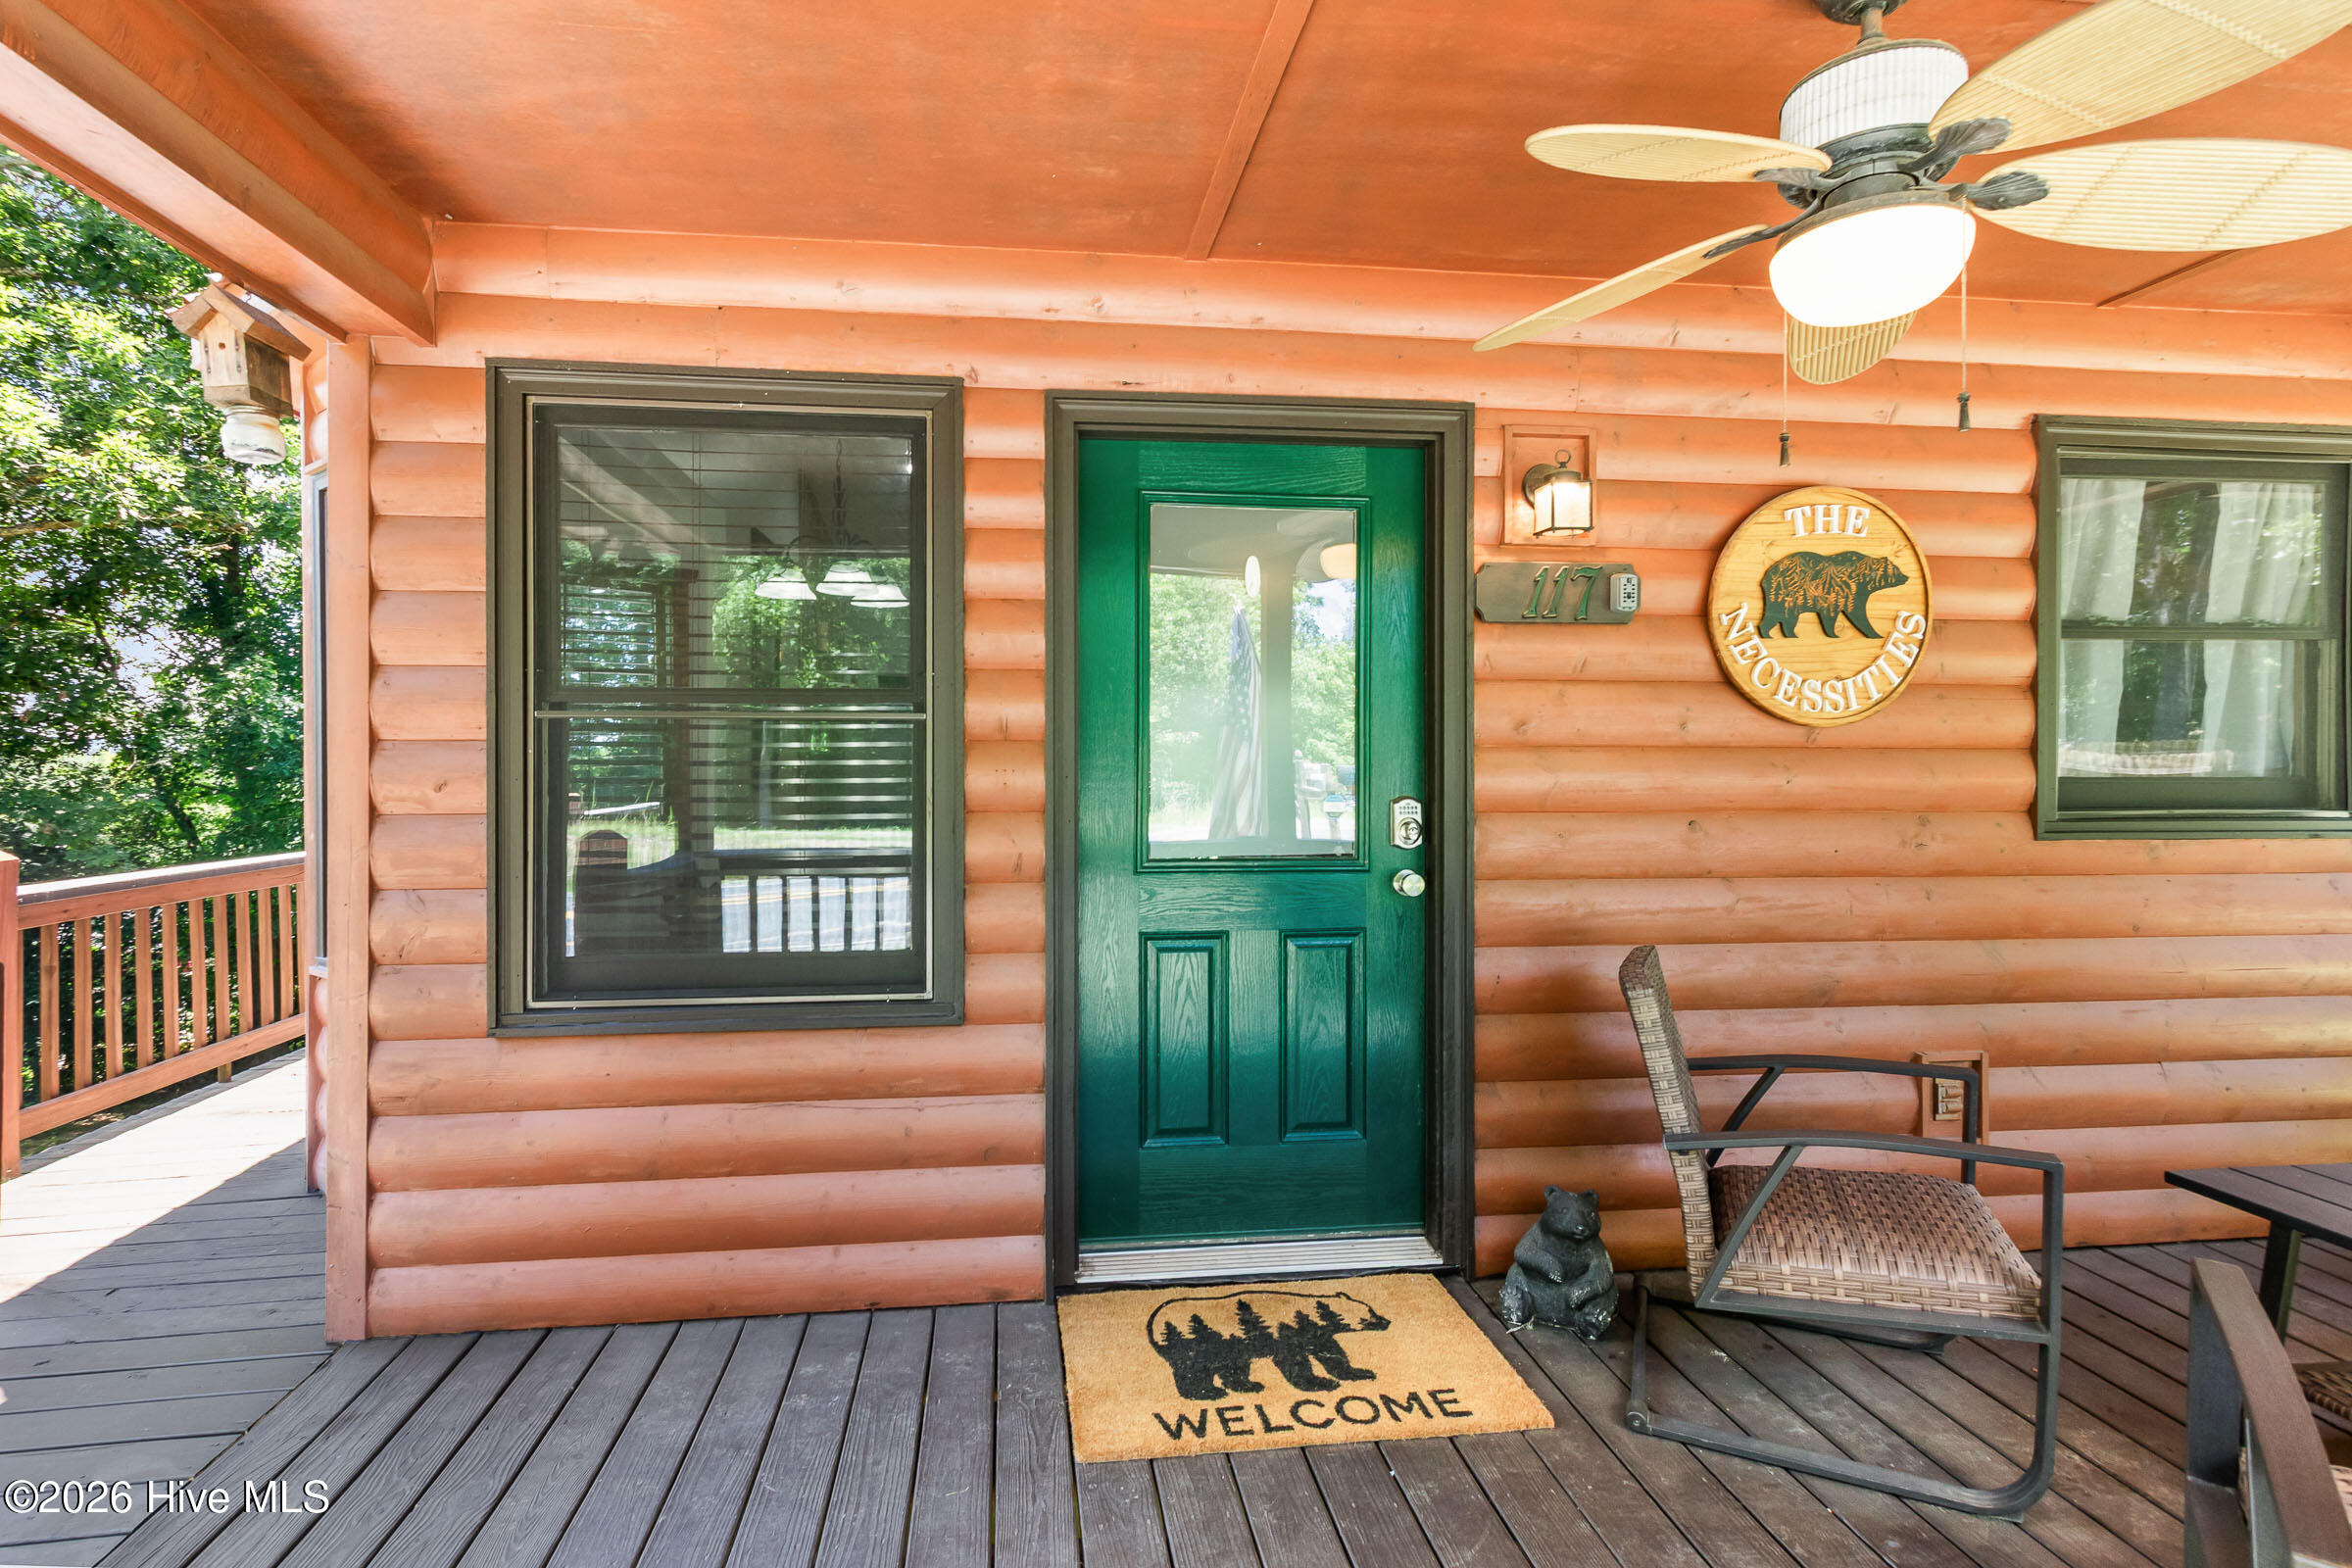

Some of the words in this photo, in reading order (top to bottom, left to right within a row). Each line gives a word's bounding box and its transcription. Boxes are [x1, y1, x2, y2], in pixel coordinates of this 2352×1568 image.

[1785, 503, 1871, 538] THE
[1522, 564, 1603, 621] 117
[1721, 602, 1927, 713] NECESSITIES
[1152, 1388, 1473, 1441] WELCOME
